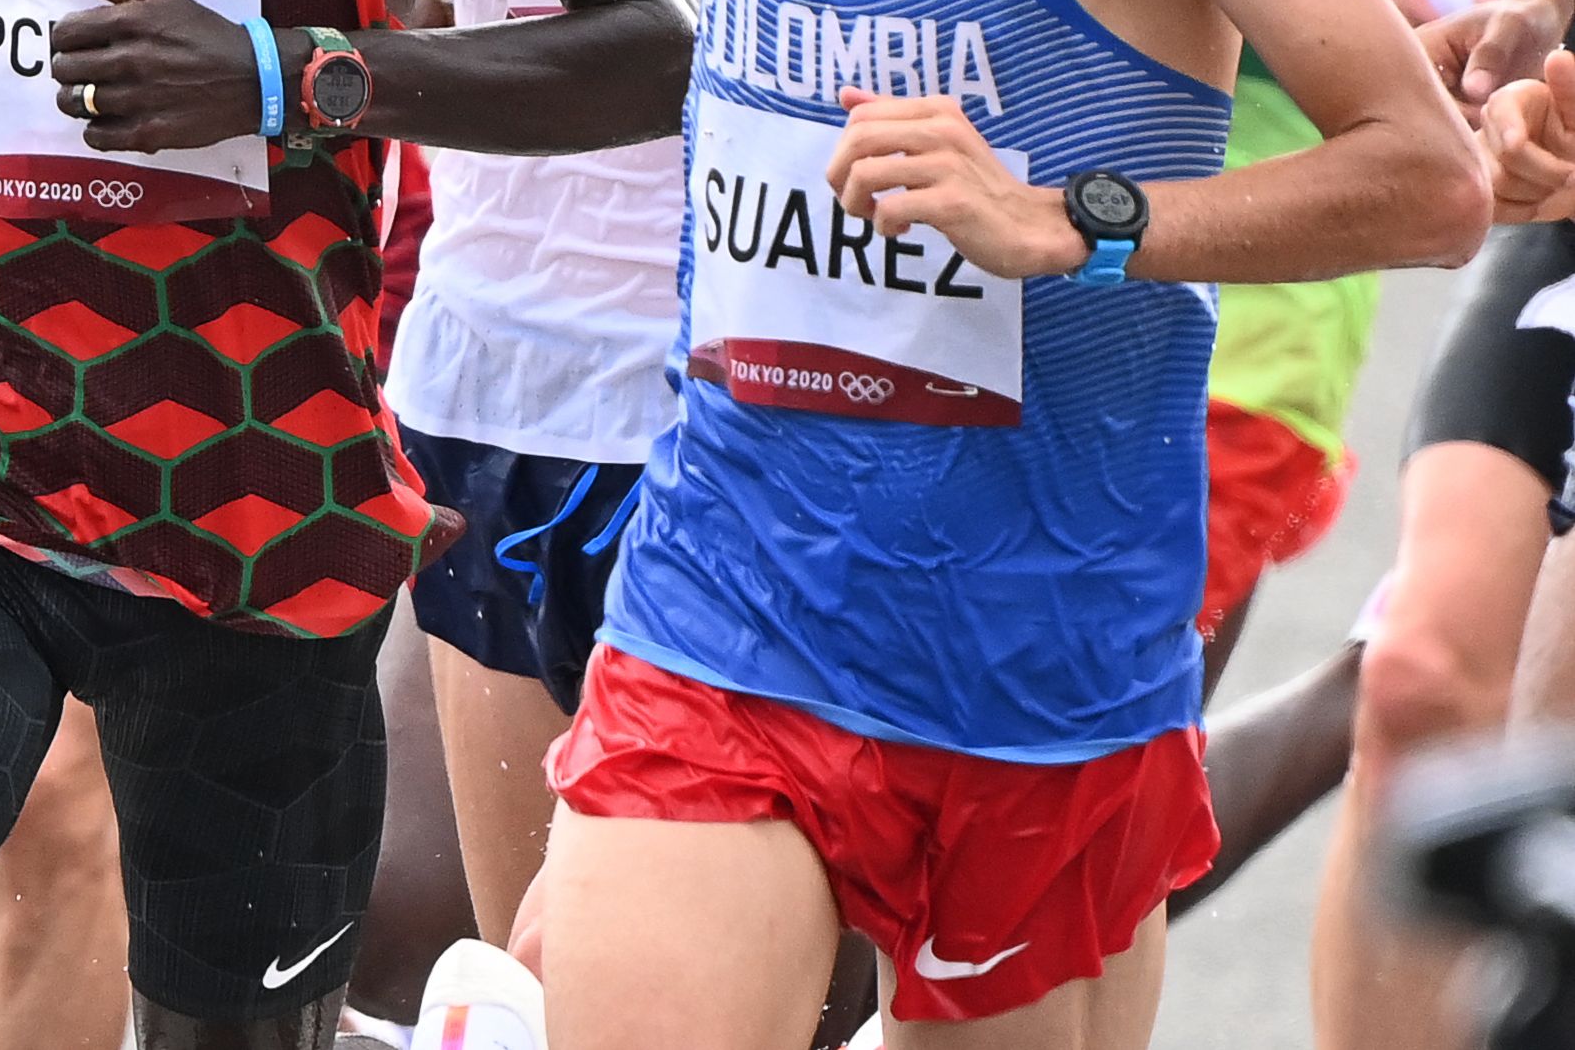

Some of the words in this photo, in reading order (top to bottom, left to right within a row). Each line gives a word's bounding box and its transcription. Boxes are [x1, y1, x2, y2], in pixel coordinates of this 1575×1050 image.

[39, 179, 83, 201] 2020
[730, 360, 785, 386] TOKYO
[787, 371, 833, 392] 2020
